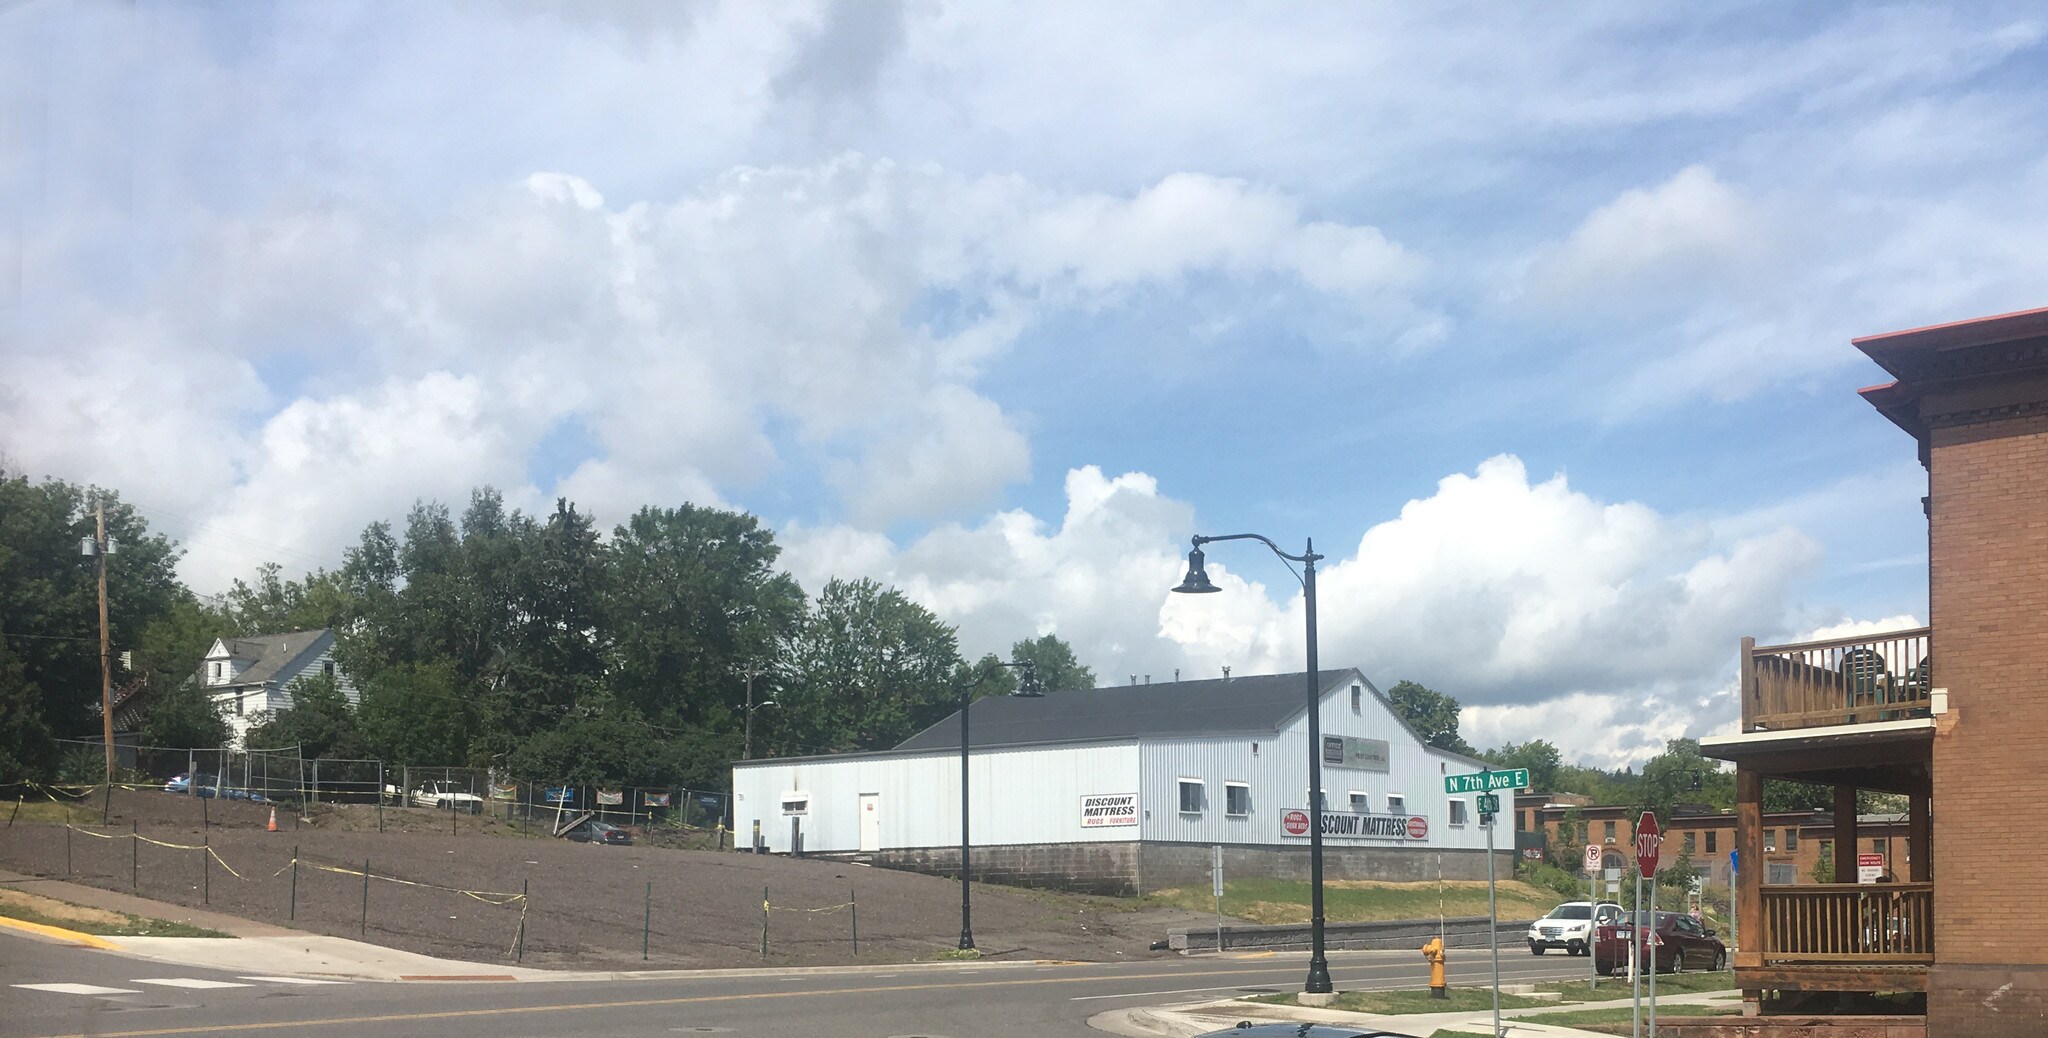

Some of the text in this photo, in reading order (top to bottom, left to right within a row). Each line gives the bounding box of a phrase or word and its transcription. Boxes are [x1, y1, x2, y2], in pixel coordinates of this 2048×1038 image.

[1449, 772, 1523, 791] N 7th Ave E
[1084, 806, 1135, 816] MATTRESS
[1085, 797, 1133, 807] DISCOUNT
[1362, 817, 1406, 837] MATTRESS
[1637, 833, 1658, 857] STOP
